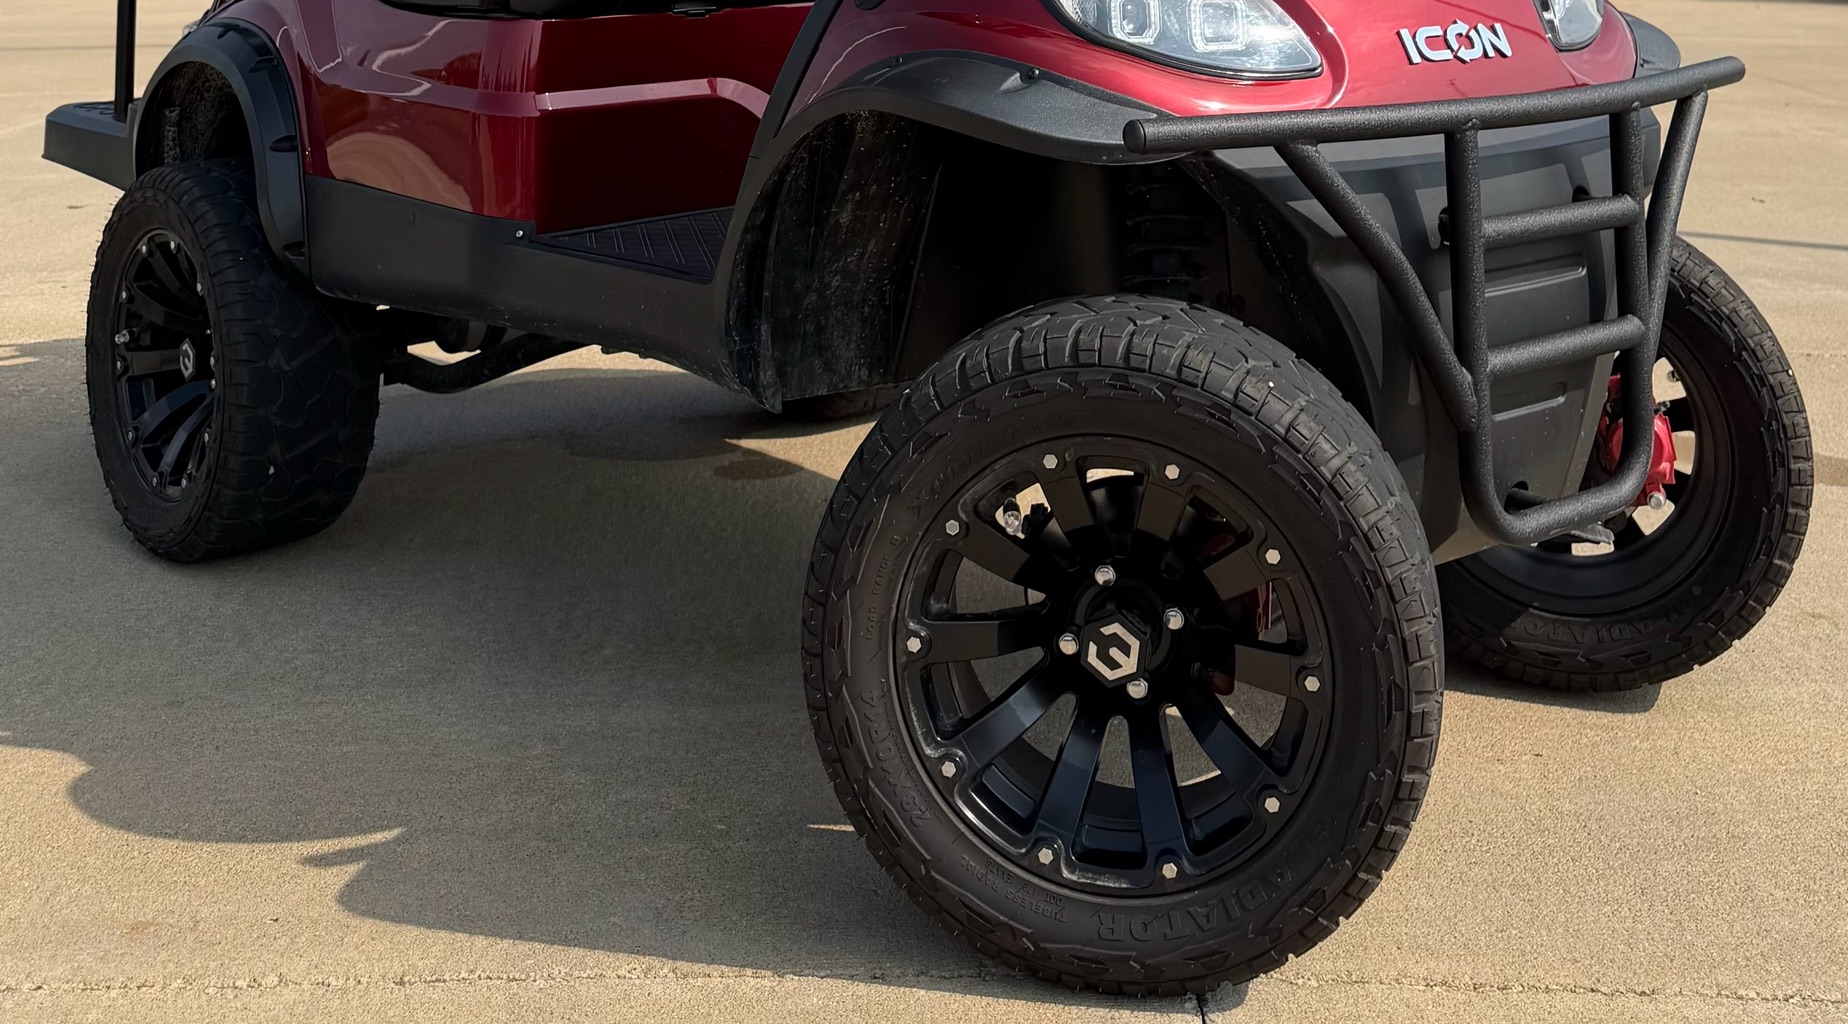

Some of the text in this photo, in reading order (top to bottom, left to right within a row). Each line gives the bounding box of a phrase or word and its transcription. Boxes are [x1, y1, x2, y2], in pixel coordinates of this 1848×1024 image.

[1397, 19, 1512, 65] ICON
[958, 854, 1067, 924] TUBELESS RADIAL
[1096, 812, 1338, 942] GLADIATOR
